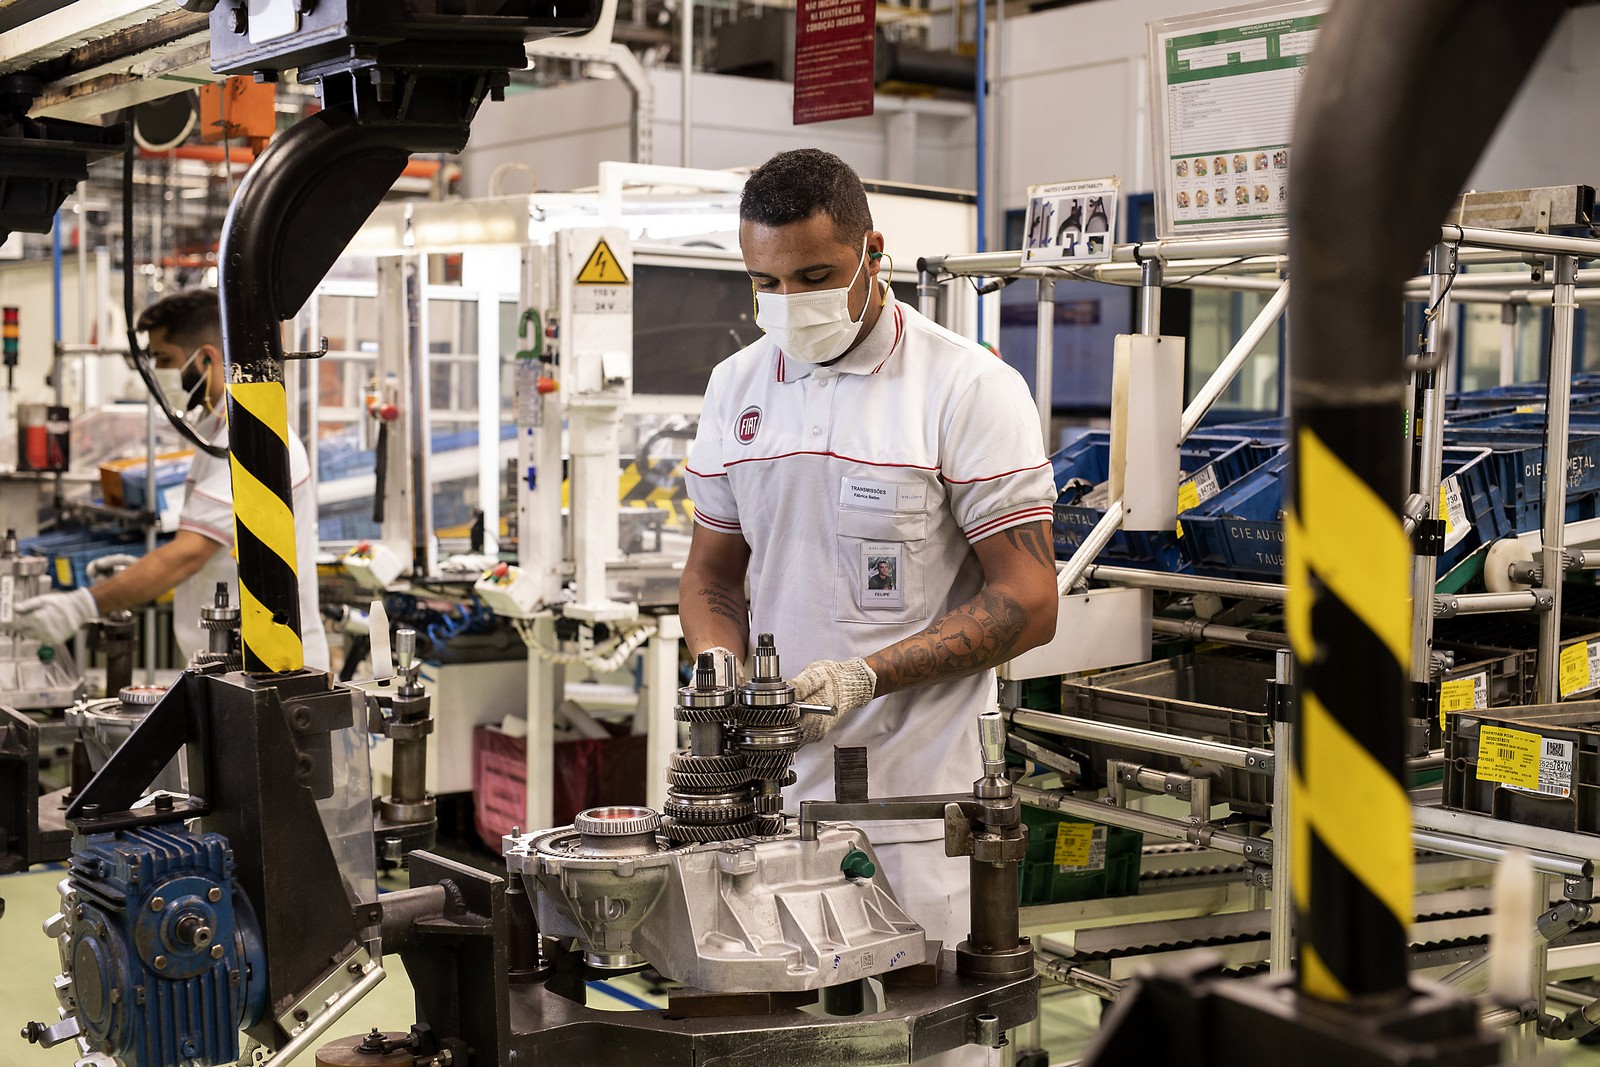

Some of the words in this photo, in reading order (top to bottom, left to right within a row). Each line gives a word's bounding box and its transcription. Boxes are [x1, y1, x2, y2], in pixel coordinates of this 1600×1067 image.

[810, 12, 818, 21] NA
[819, 6, 852, 20] EXISTÊNCIA
[853, 4, 861, 13] DE
[806, 19, 836, 33] CONDIÇÃO
[836, 15, 865, 27] INSEGURA
[594, 288, 608, 296] 110
[610, 288, 617, 296] V
[596, 303, 606, 311] 24
[741, 416, 758, 436] FIAT
[1525, 463, 1542, 477] CIE
[851, 485, 887, 496] TRANSMISSÕES
[1231, 527, 1253, 540] CIE
